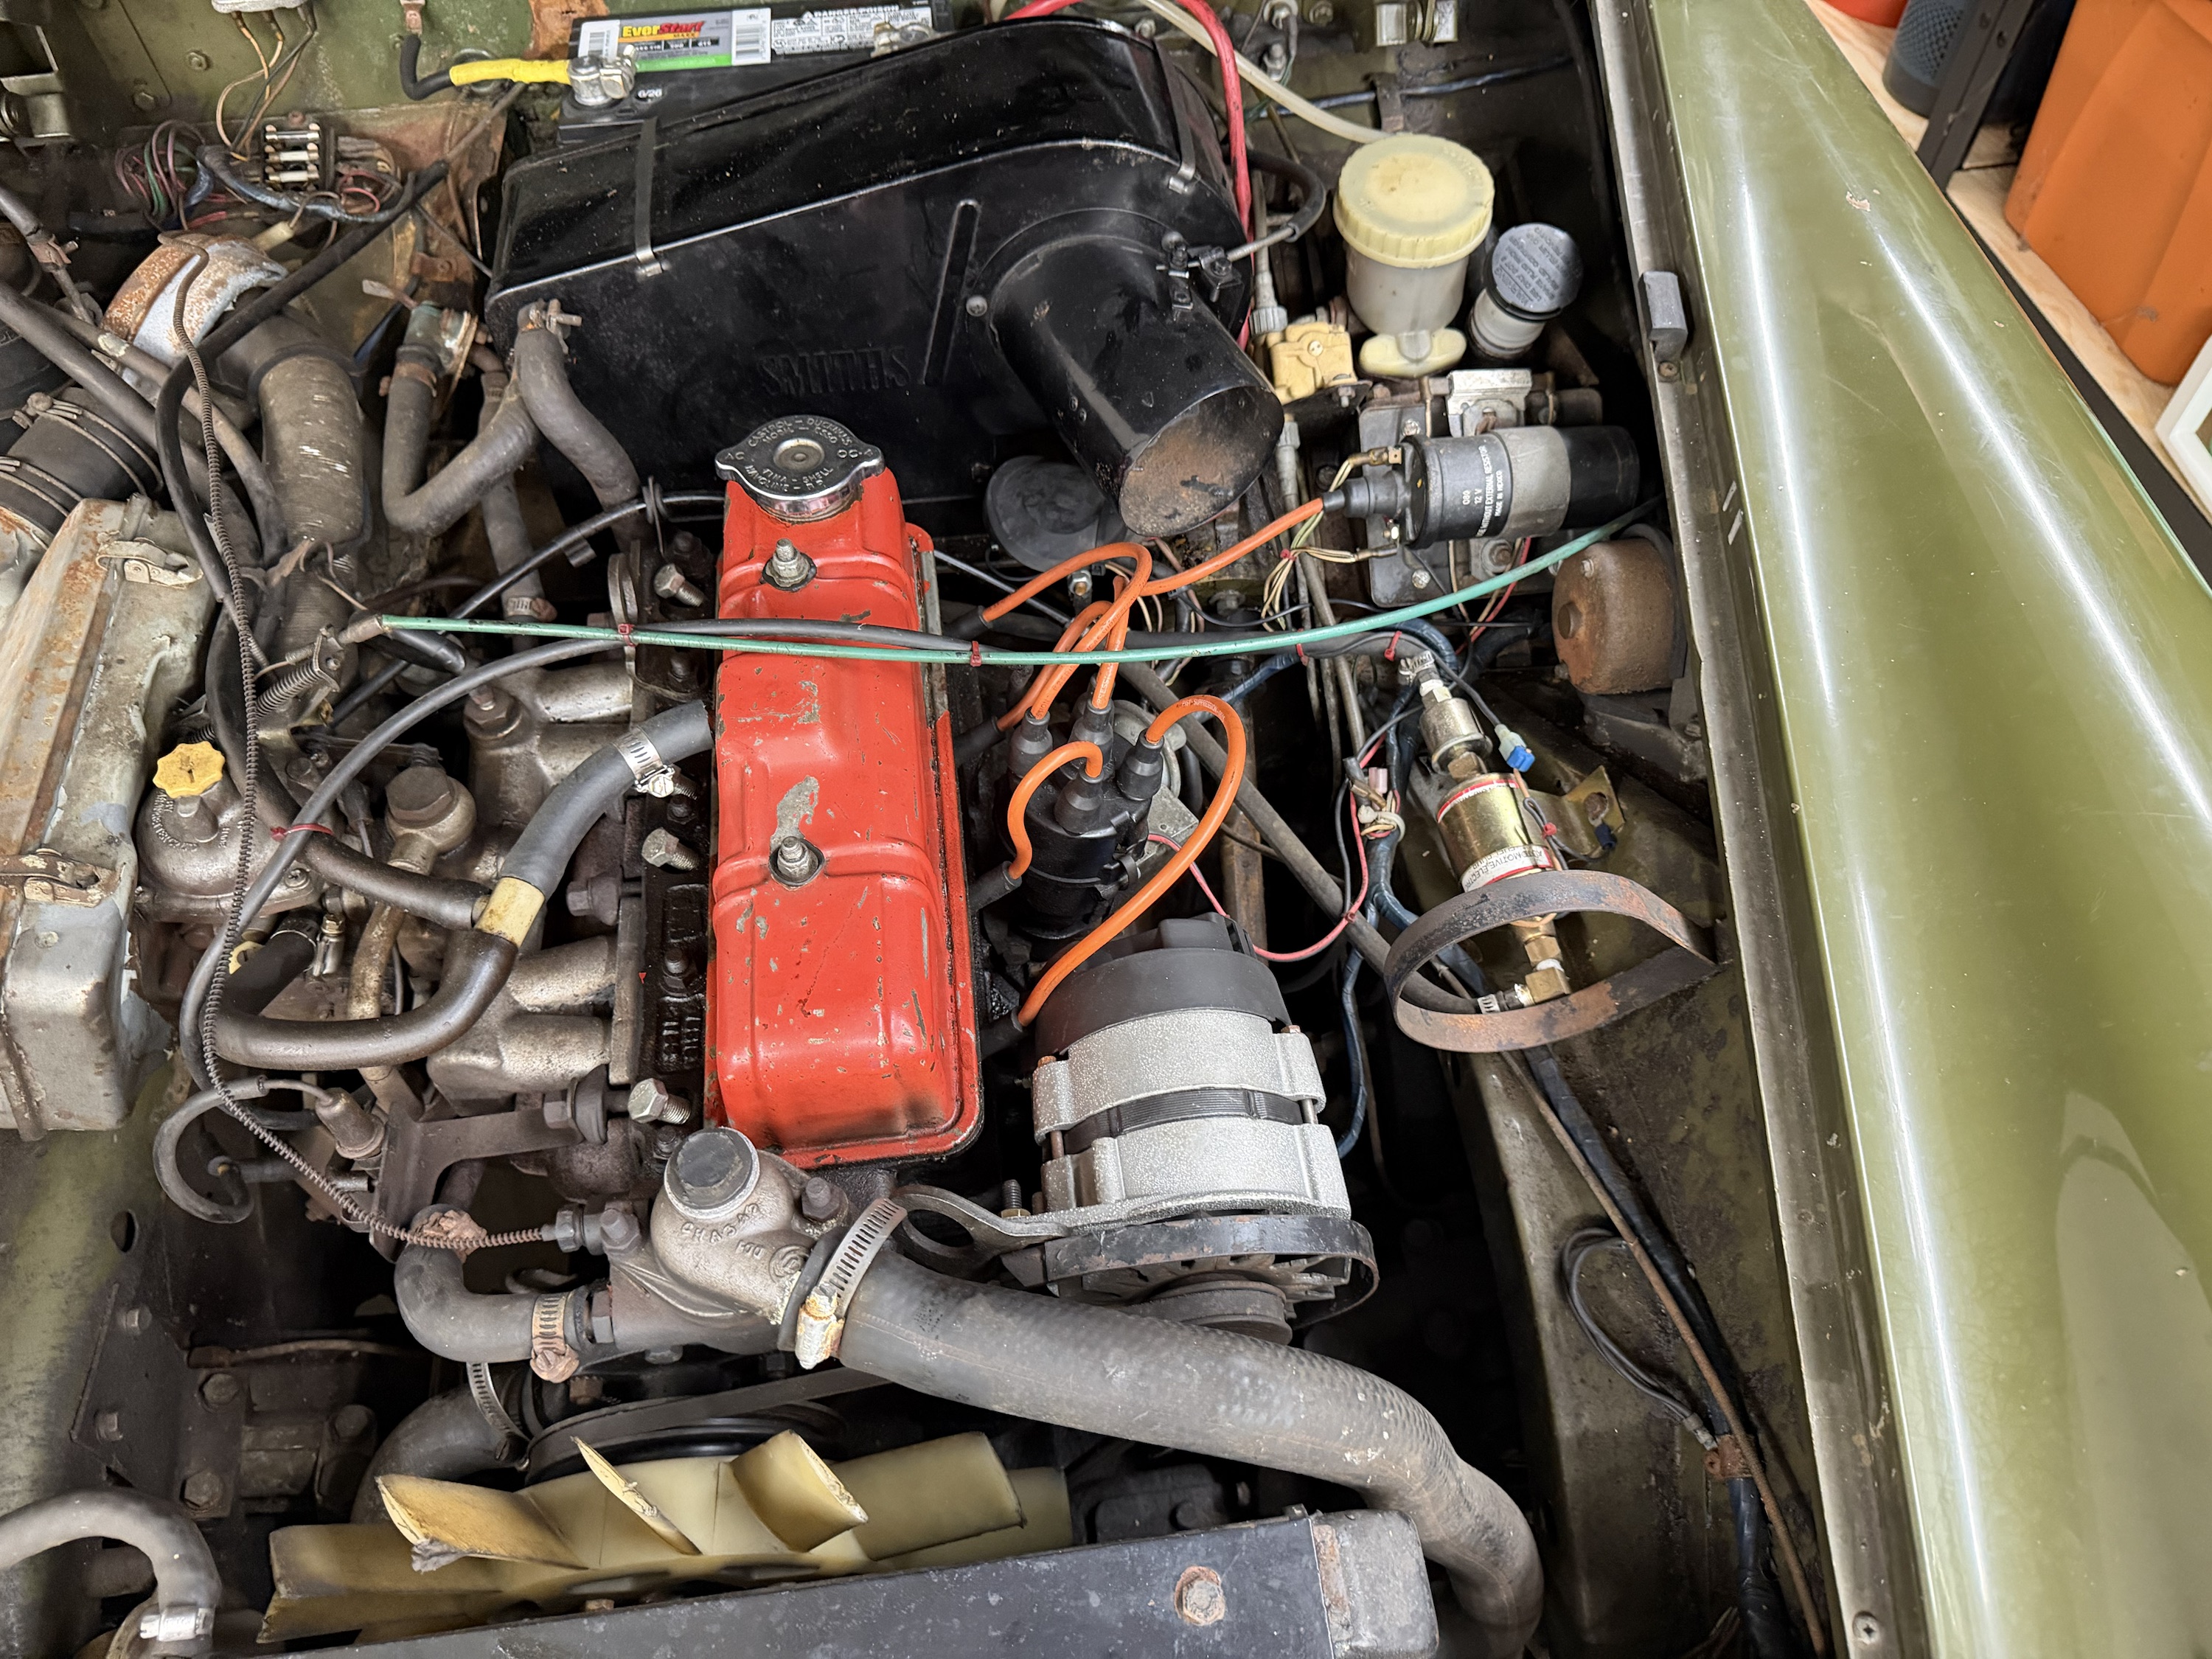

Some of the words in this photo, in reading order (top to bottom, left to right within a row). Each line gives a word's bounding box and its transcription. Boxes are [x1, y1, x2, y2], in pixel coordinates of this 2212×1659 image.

[748, 420, 793, 447] CASTROL
[1478, 445, 1492, 474] RESISTOR
[1474, 495, 1483, 504] 12
[1485, 474, 1494, 505] EXTERNAL
[1481, 506, 1493, 529] WITHOUT
[1495, 501, 1503, 517] MADE
[1487, 849, 1543, 869] AUTOMOTIVE
